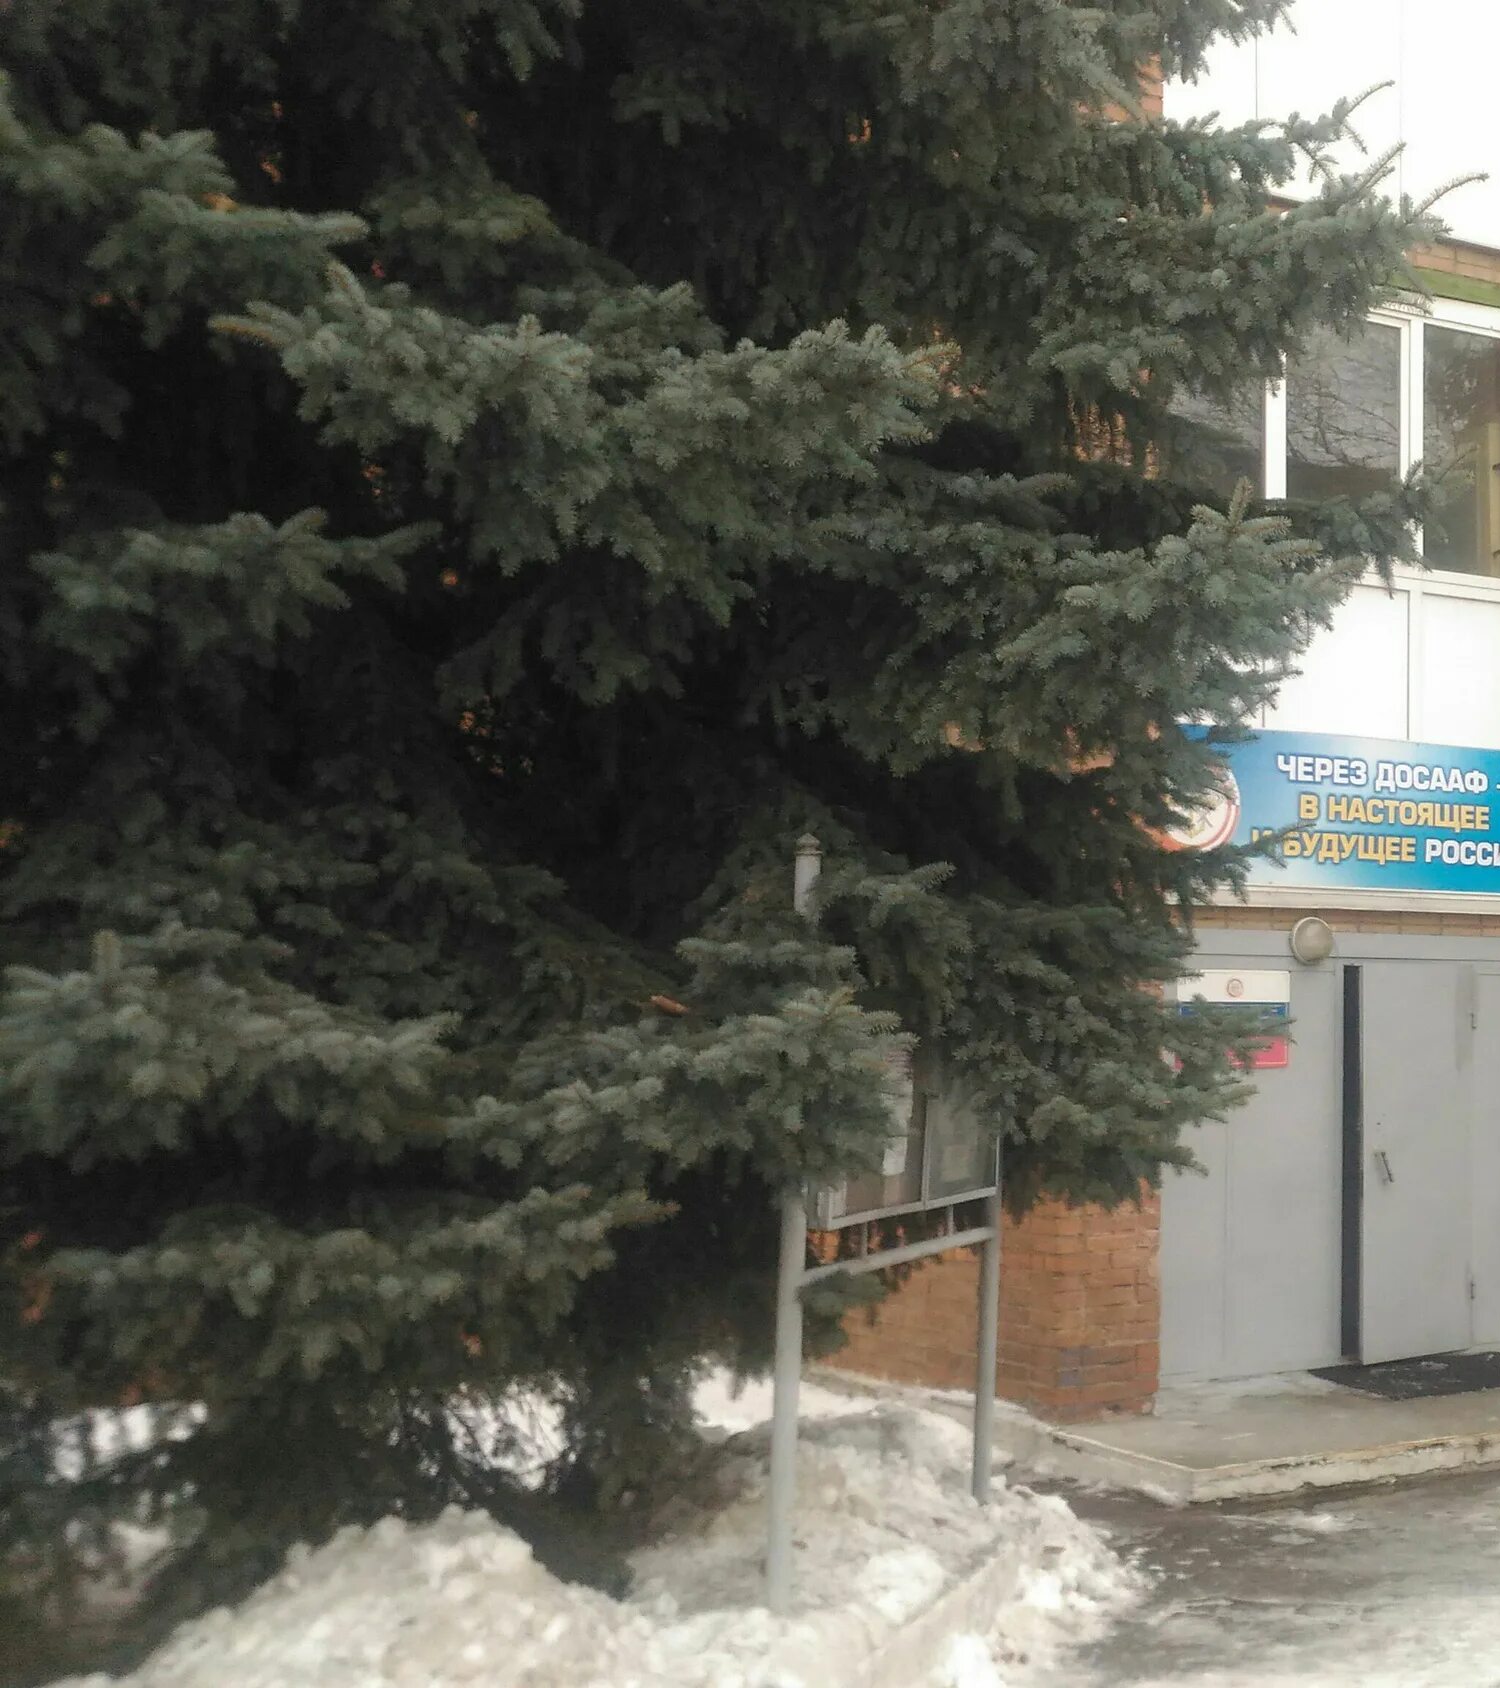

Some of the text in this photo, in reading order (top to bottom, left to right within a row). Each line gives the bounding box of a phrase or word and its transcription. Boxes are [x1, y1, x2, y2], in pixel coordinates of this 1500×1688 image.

[1277, 754, 1367, 785] ЧЕРЕЗ
[1375, 763, 1489, 794] ДОСААФ
[1299, 794, 1490, 832] В НАСТОЯЩЕЕ
[1283, 831, 1416, 864] БУДУЩЕЕ
